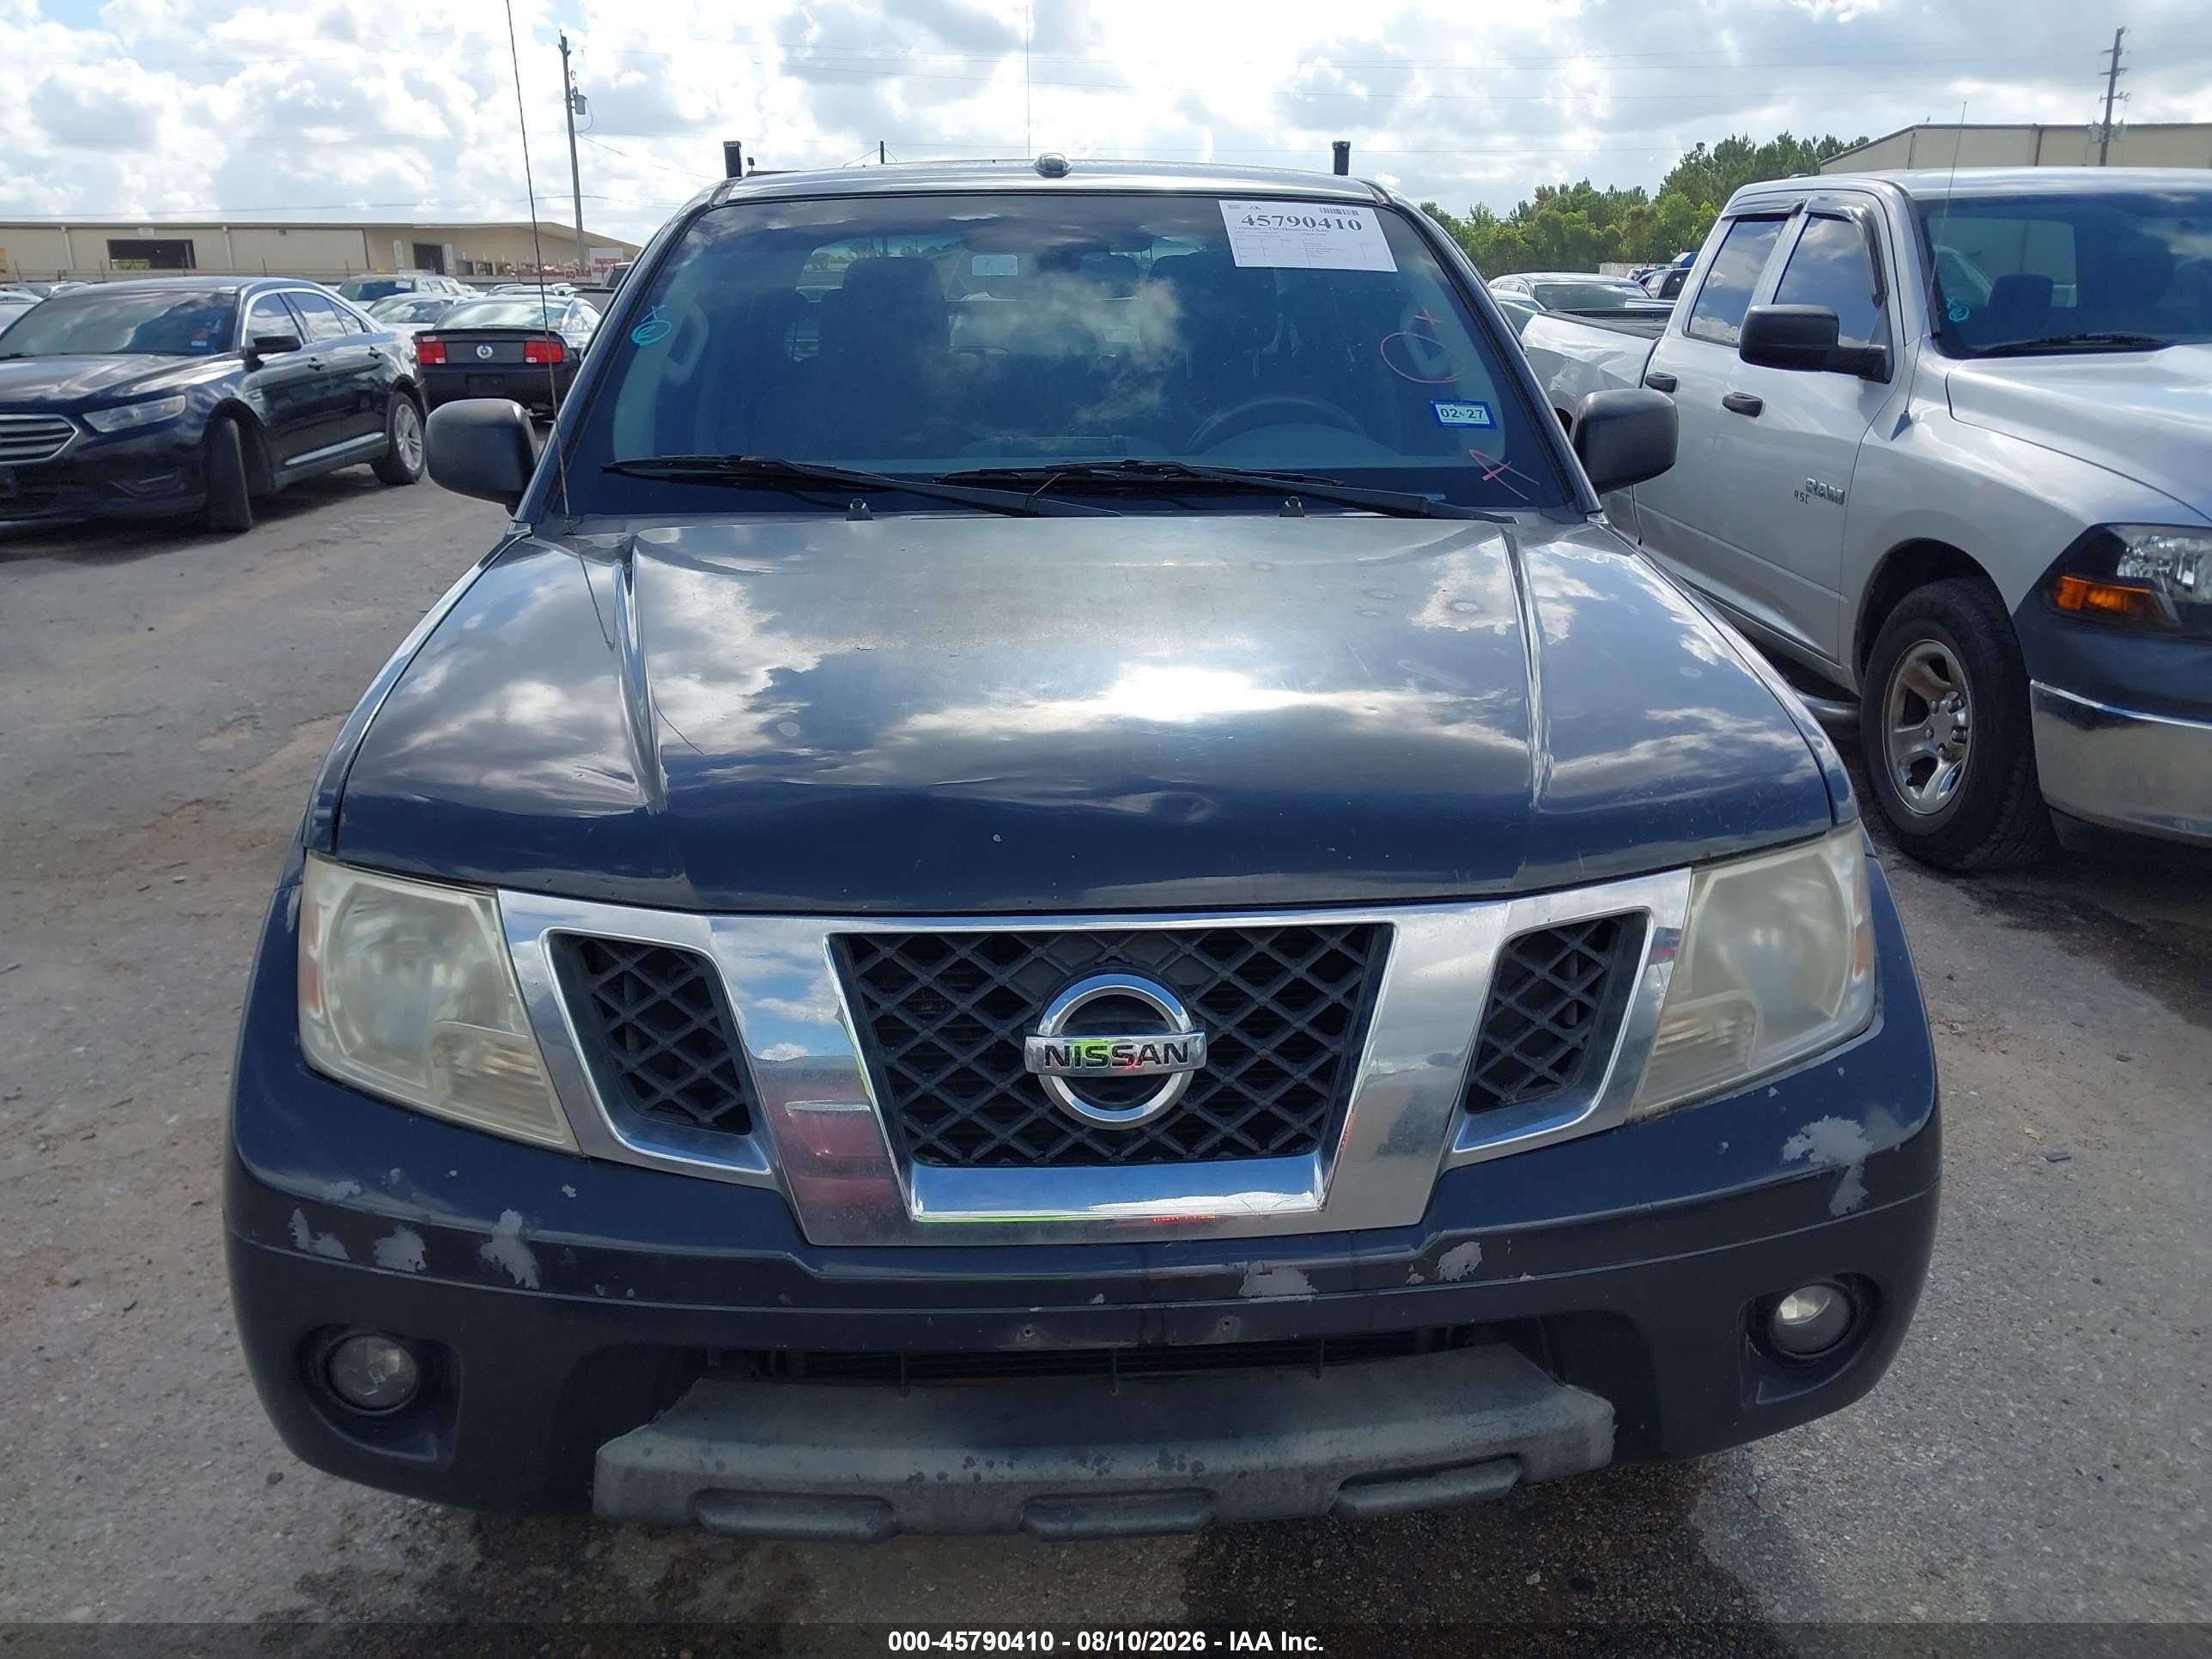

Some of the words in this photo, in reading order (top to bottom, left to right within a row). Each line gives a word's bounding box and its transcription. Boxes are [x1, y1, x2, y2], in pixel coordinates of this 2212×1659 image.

[1242, 214, 1363, 231] 45790410
[1806, 477, 1845, 505] RAM
[1044, 1042, 1189, 1068] NISSAN
